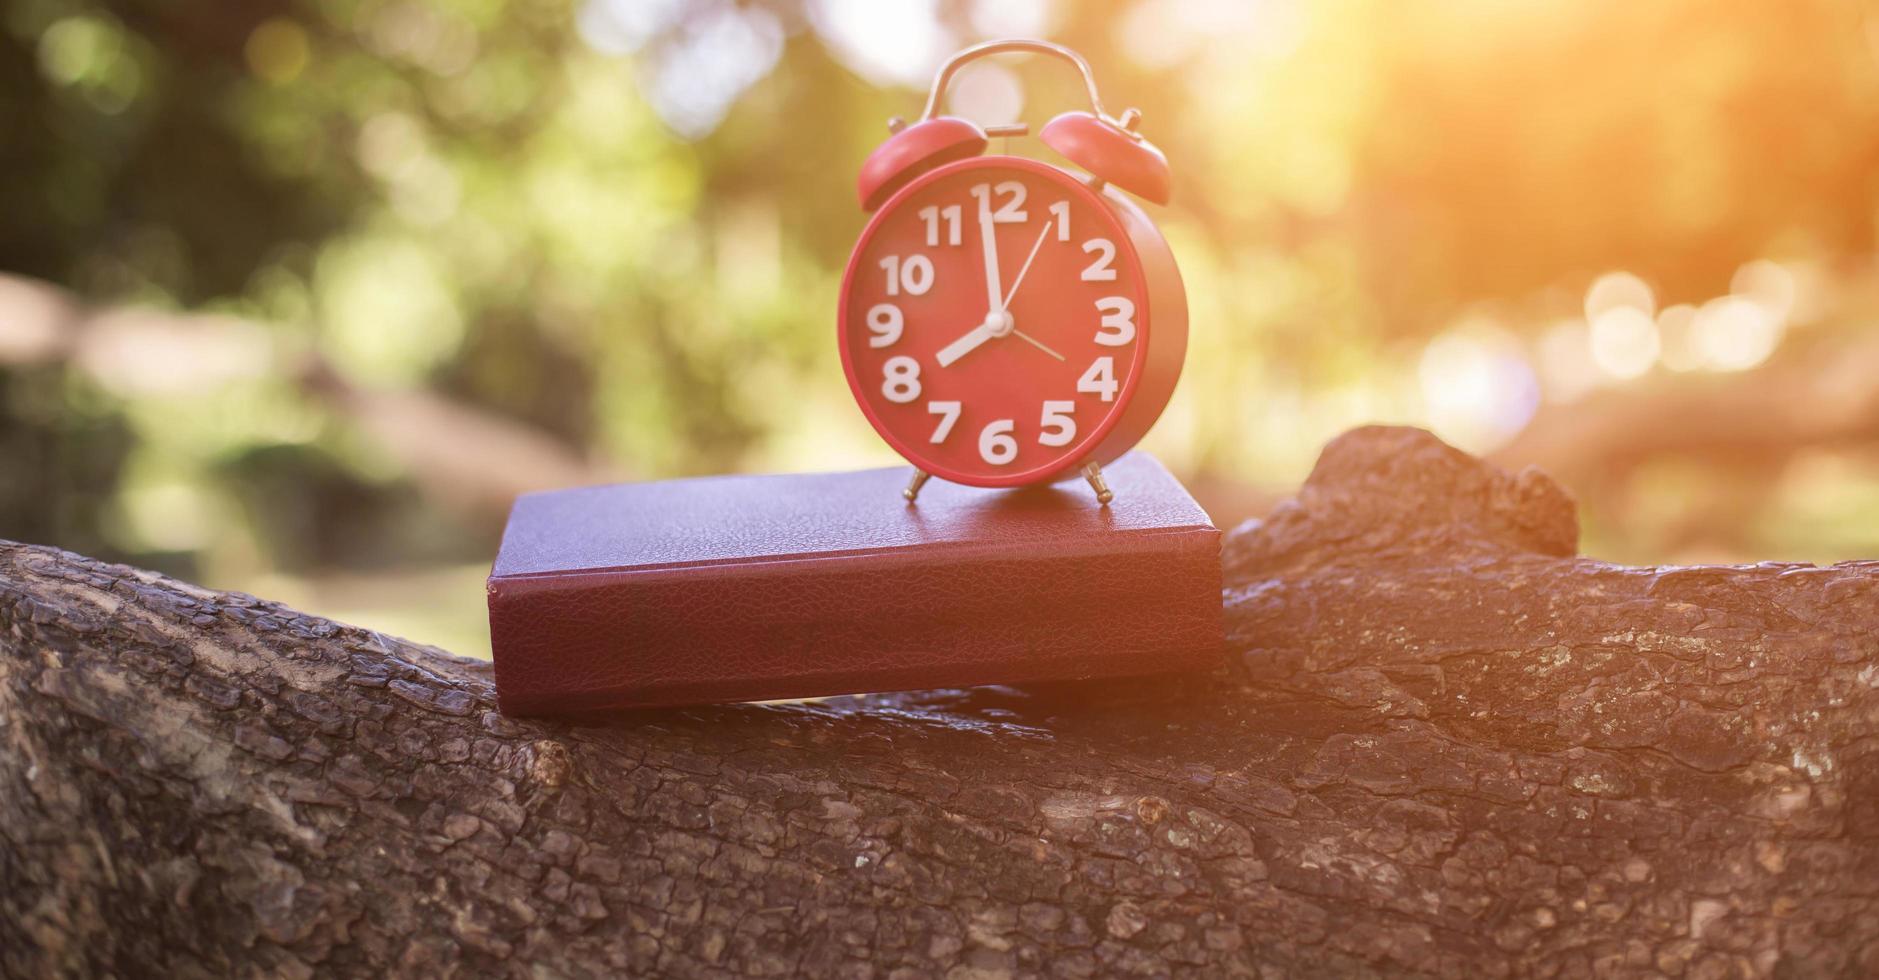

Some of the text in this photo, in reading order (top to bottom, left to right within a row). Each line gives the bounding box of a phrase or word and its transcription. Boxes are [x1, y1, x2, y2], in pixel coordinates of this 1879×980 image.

[970, 181, 1027, 223] 12
[1049, 200, 1069, 241] 1
[918, 205, 961, 245] 11
[878, 254, 934, 295] 10
[1080, 238, 1117, 280] 2
[866, 303, 903, 347] 9
[1093, 296, 1135, 346] 3
[881, 356, 921, 402] 8
[1076, 356, 1117, 401] 4
[927, 401, 961, 443] 7
[978, 419, 1017, 465] 6
[1038, 400, 1076, 446] 5
